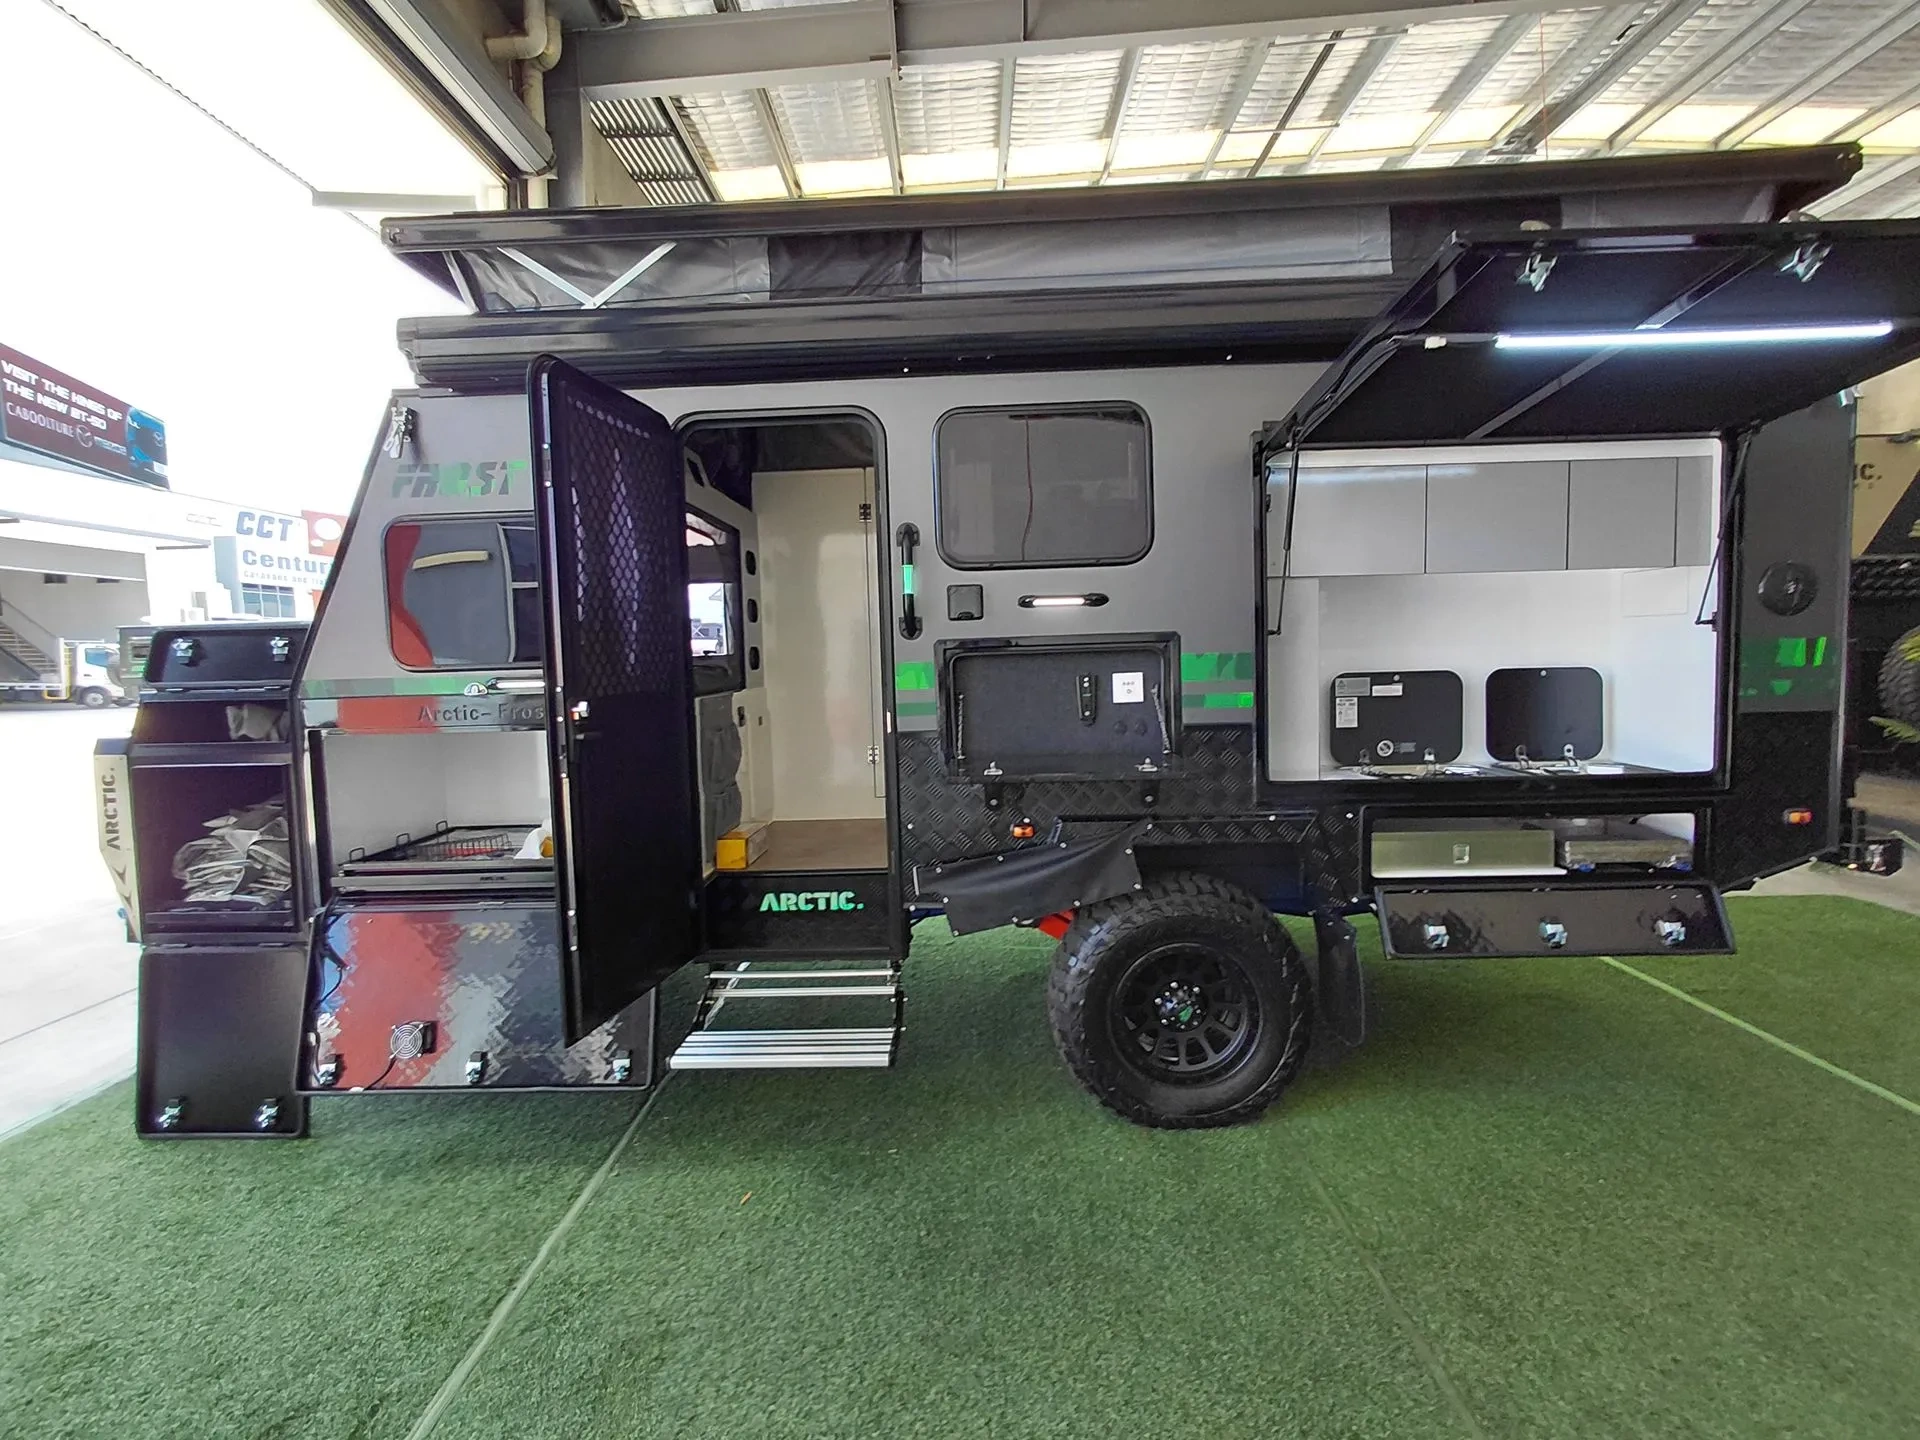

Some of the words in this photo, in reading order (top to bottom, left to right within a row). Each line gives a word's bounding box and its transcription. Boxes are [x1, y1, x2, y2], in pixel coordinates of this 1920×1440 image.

[1, 360, 39, 385] VISIT
[41, 378, 70, 399] THE
[107, 408, 123, 421] OF
[2, 378, 35, 401] THE
[36, 392, 68, 414] NEW
[6, 402, 75, 438] CABOOLTURE
[236, 511, 293, 541] CCT
[242, 549, 329, 575] Centur
[498, 703, 545, 720] Fros
